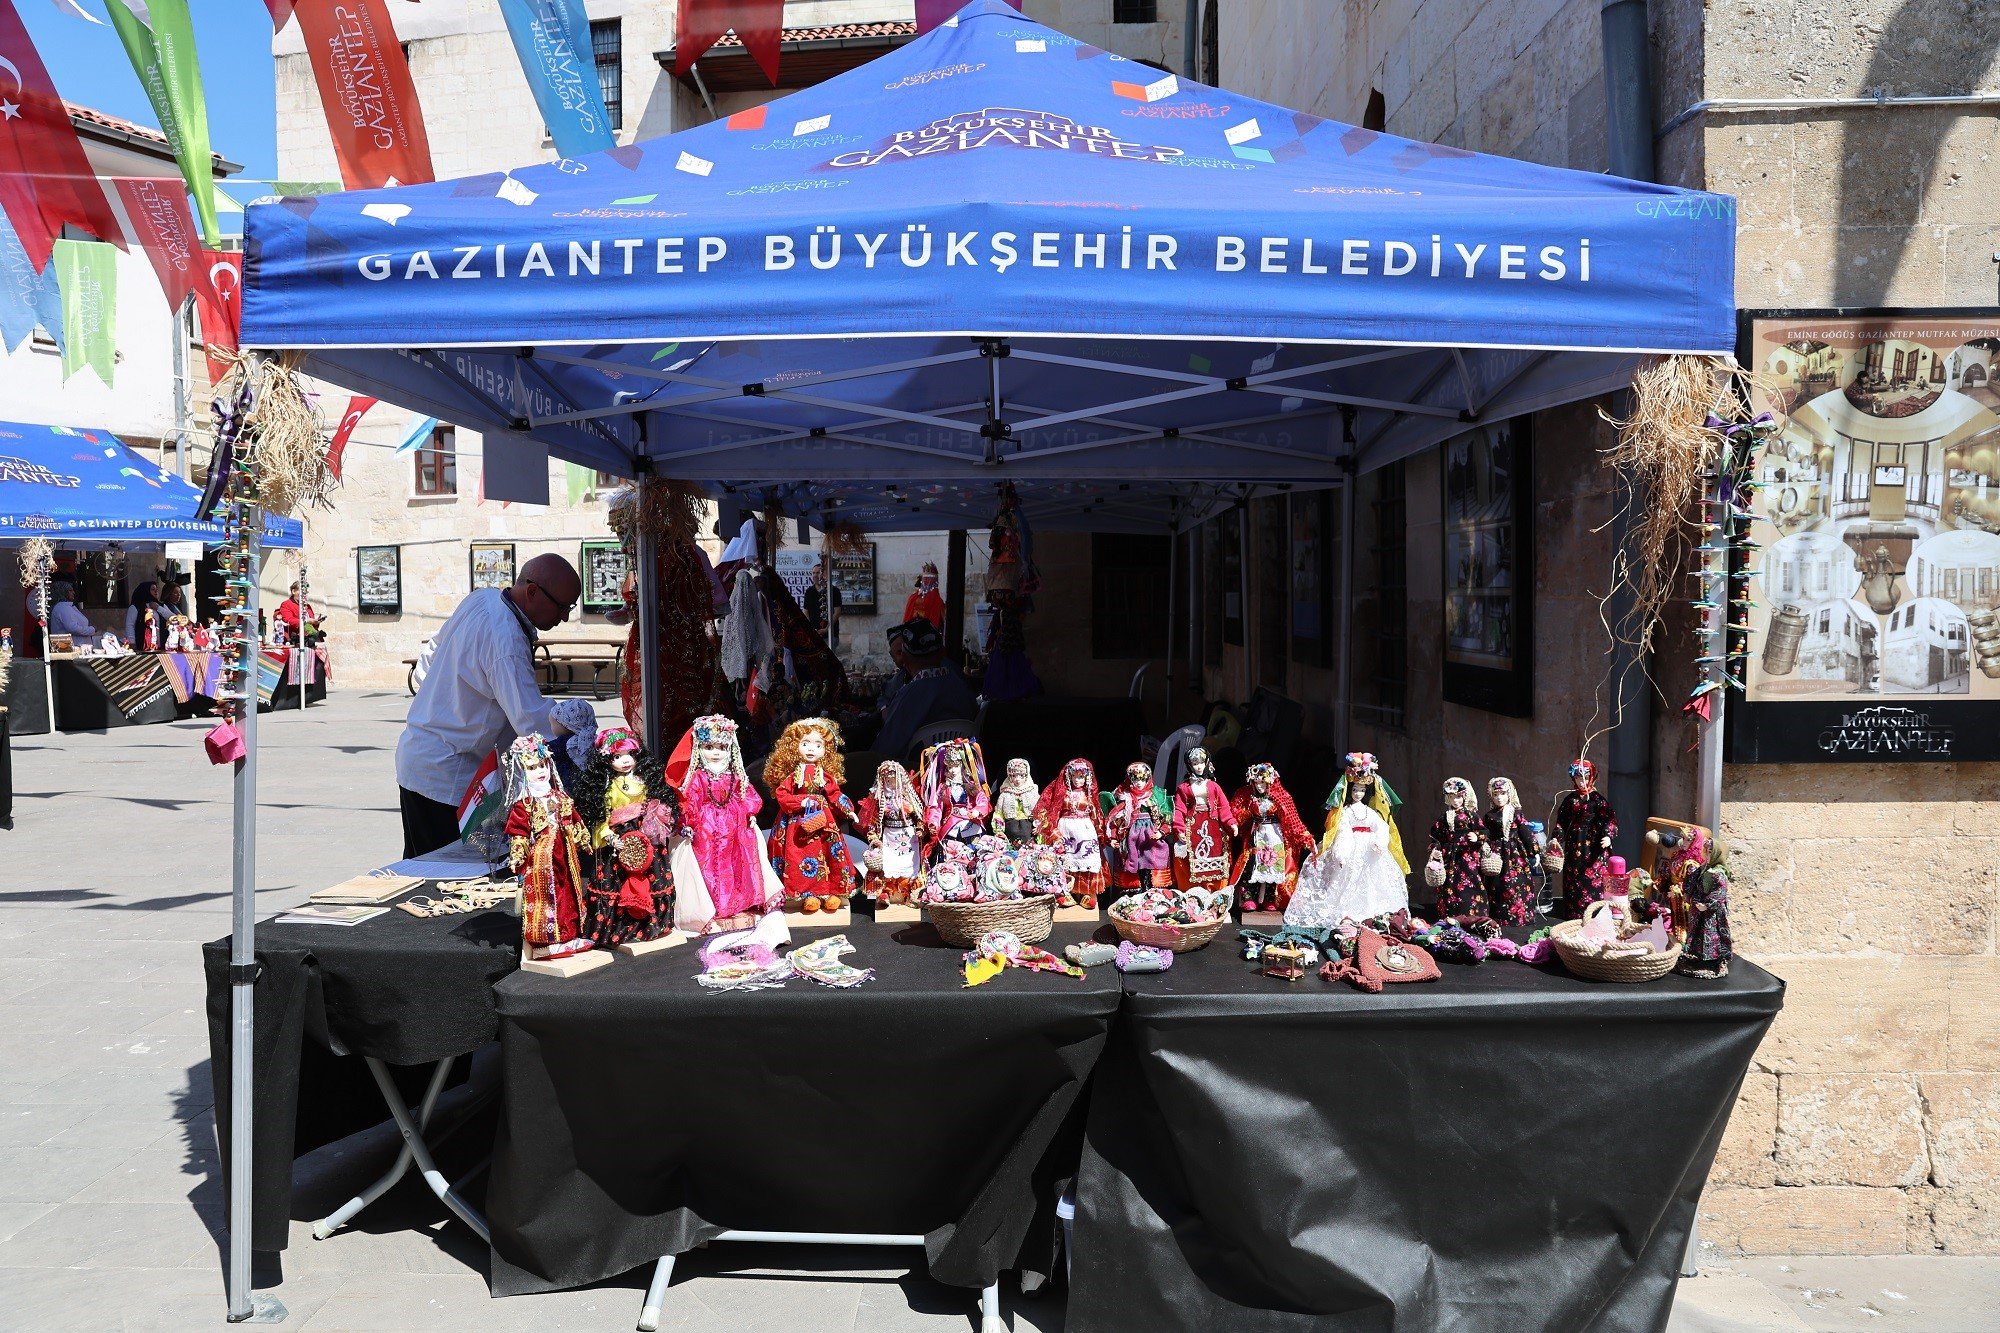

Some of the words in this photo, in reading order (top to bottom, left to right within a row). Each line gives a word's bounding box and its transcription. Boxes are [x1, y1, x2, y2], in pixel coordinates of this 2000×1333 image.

[763, 224, 1178, 274] BÜYÜKŞEHİR
[1214, 233, 1591, 283] BELEDİYESİ
[1787, 331, 1818, 339] EMİNE
[1858, 330, 1914, 339] GAZİANTEP
[1961, 329, 2000, 338] MÜZESİ
[1840, 714, 1931, 730] BÜYÜKŞEHİR
